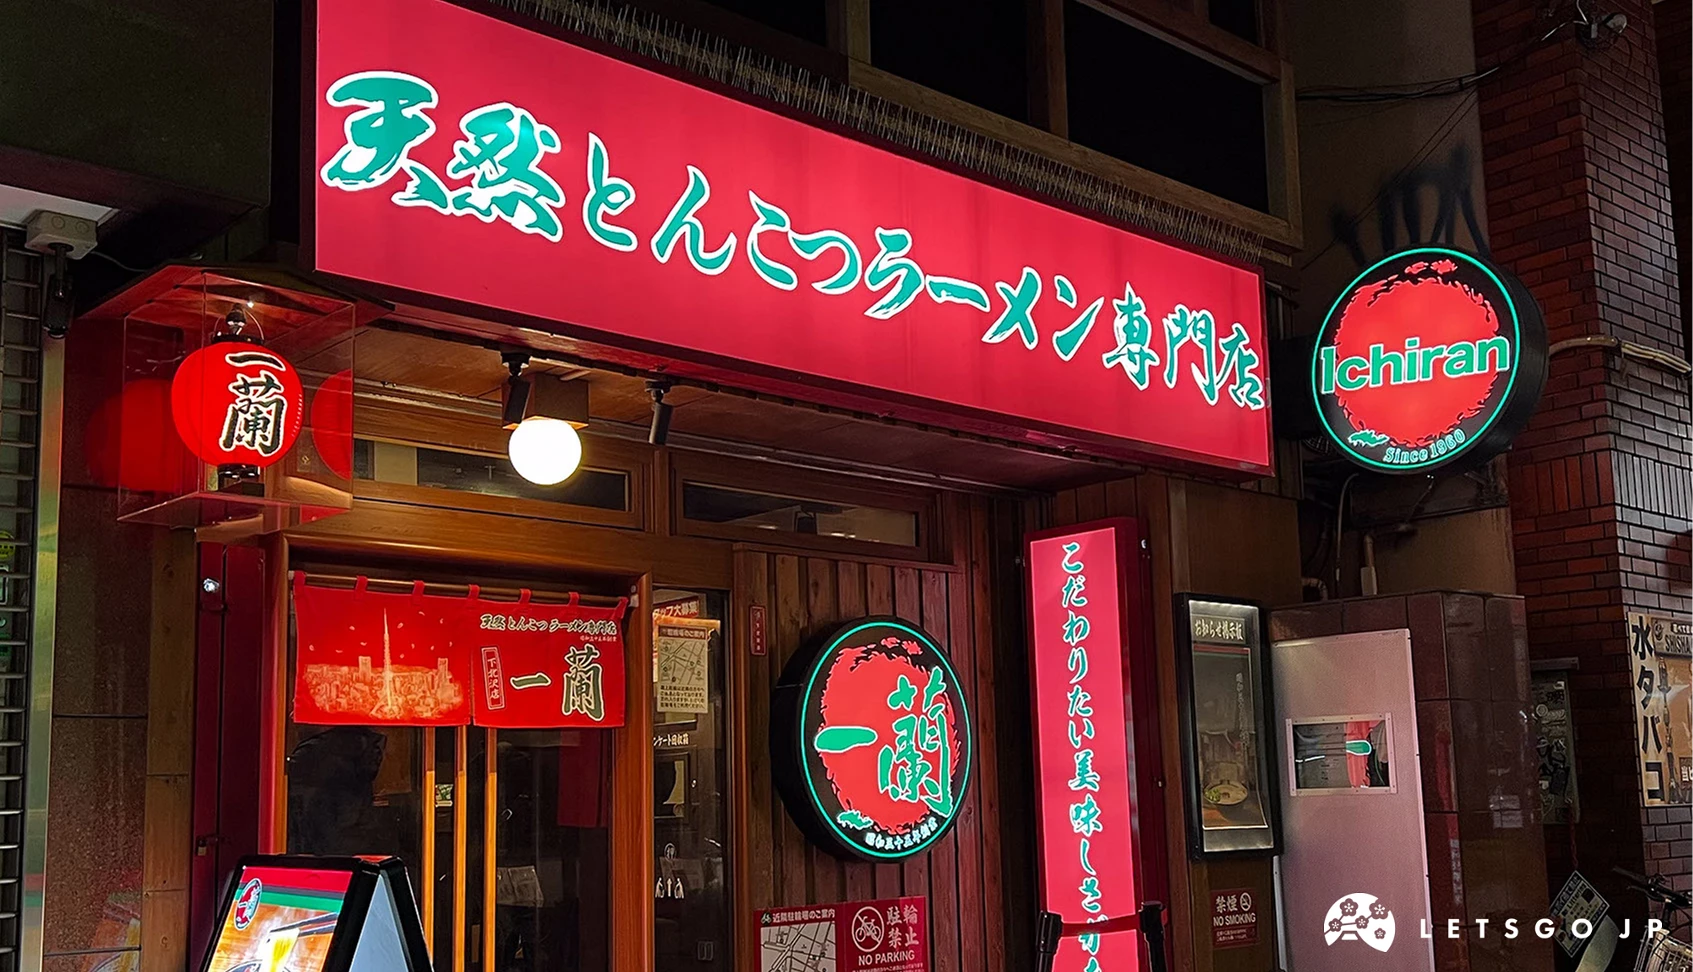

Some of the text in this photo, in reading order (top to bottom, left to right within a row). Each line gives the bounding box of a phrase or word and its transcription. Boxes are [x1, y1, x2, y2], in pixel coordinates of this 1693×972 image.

[320, 70, 1265, 410] 天然とんこつラーメン専門店
[1321, 336, 1510, 394] Ichiran
[219, 351, 288, 457] 一蘭
[1383, 428, 1466, 464] Since 1960
[487, 658, 500, 699] 下北沢店
[510, 643, 604, 721] 一蘭
[1632, 616, 1665, 801] 水タバコ
[814, 666, 953, 818] 一蘭
[1061, 541, 1103, 972] こだわりたい美味しさが
[886, 904, 918, 925] 駐輪
[1213, 912, 1256, 926] NO SMOKING
[1215, 895, 1238, 913] 禁煙
[858, 950, 915, 966] NO PARKING
[887, 926, 919, 948] 禁止
